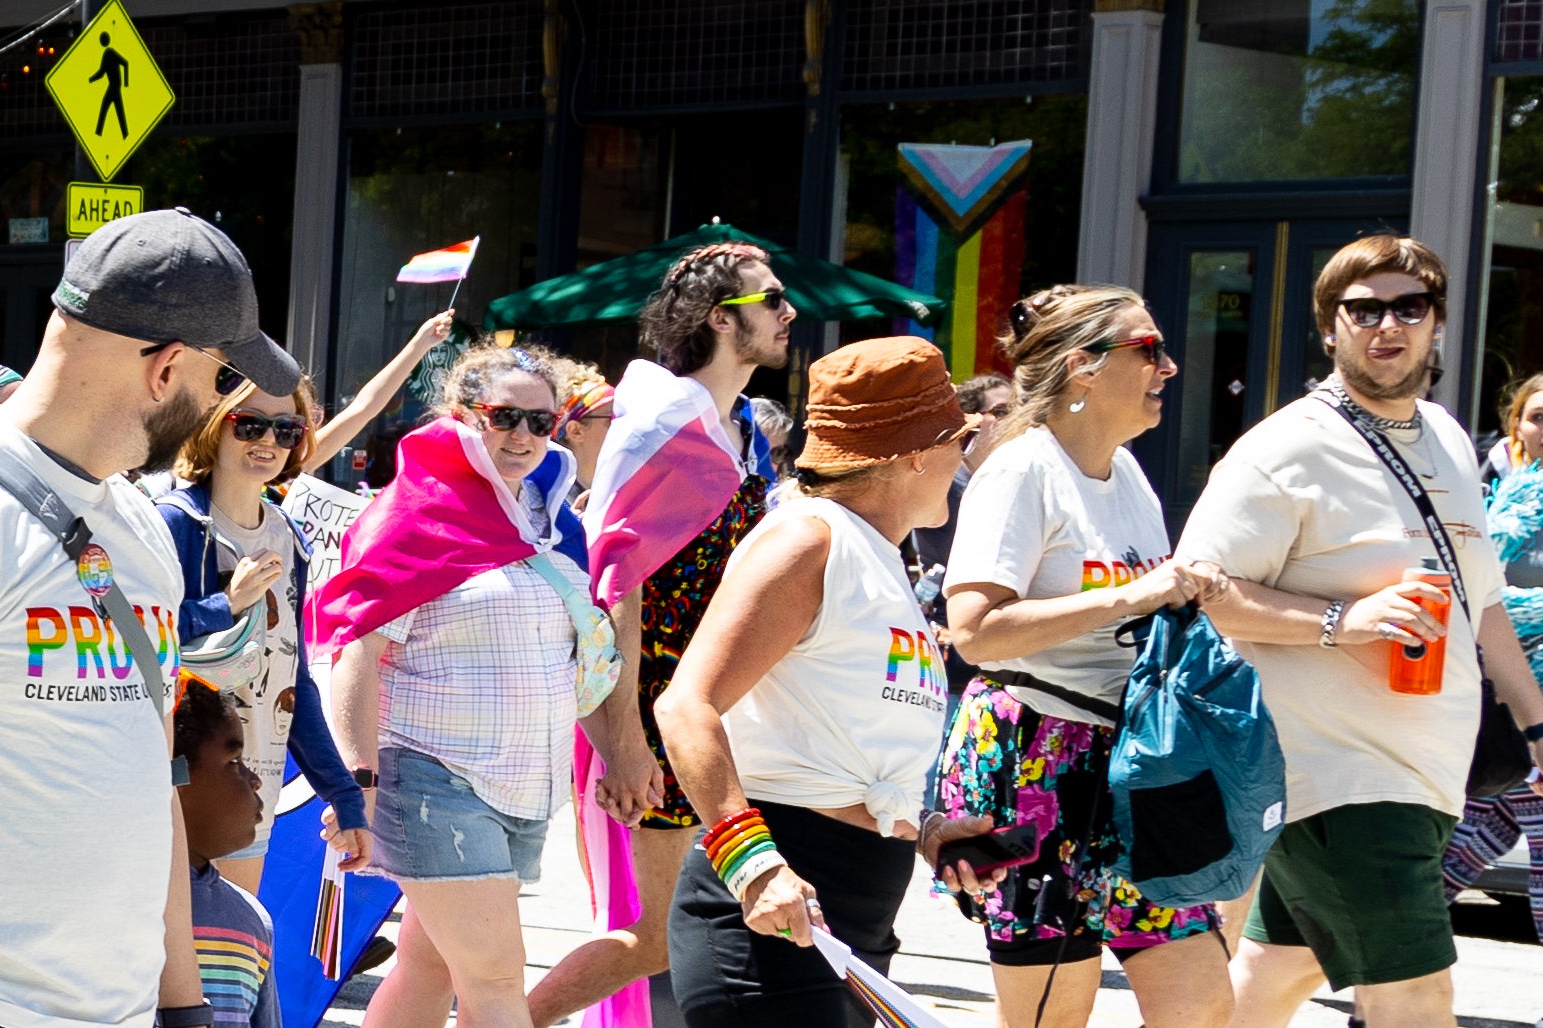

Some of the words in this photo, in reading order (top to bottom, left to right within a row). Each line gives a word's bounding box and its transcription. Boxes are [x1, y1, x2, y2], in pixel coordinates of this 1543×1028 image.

[77, 198, 133, 222] AHEAD
[290, 482, 359, 527] PROTE
[25, 683, 107, 702] CLEVELAND
[110, 684, 141, 702] STATE
